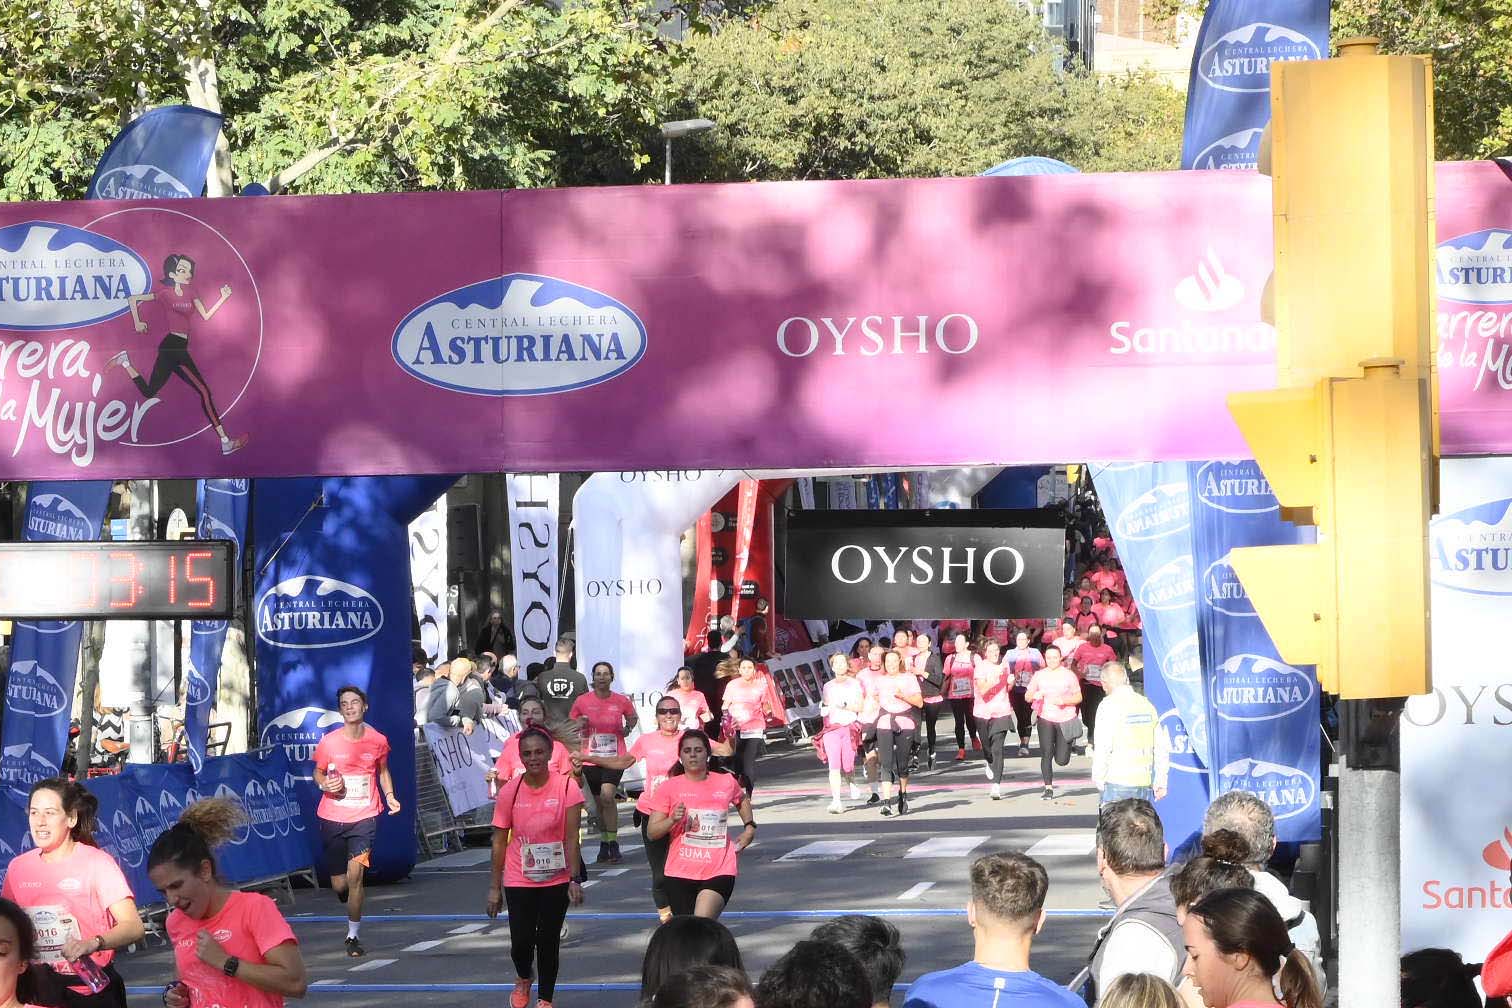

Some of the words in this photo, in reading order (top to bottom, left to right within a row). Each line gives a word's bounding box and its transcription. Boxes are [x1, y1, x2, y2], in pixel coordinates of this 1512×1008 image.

[1208, 52, 1309, 78] ASTUR
[54, 257, 127, 270] LECHERA
[450, 316, 527, 331] CENTRAL
[534, 313, 620, 329] LECHERA
[1437, 309, 1512, 341] arrer
[411, 322, 627, 365] ASTURIANA
[776, 312, 980, 358] OYSHO
[12, 371, 161, 467] Mujer
[831, 545, 1025, 585] OYSHO
[586, 578, 663, 599] OYSHO
[274, 600, 316, 609] CENTRAL
[321, 600, 370, 609] LECHERA
[261, 608, 374, 633] ASTURIANA
[553, 681, 569, 693] BP
[276, 733, 317, 741] CENTRAL
[679, 848, 712, 860] SUMA
[1423, 881, 1512, 911] Santa
